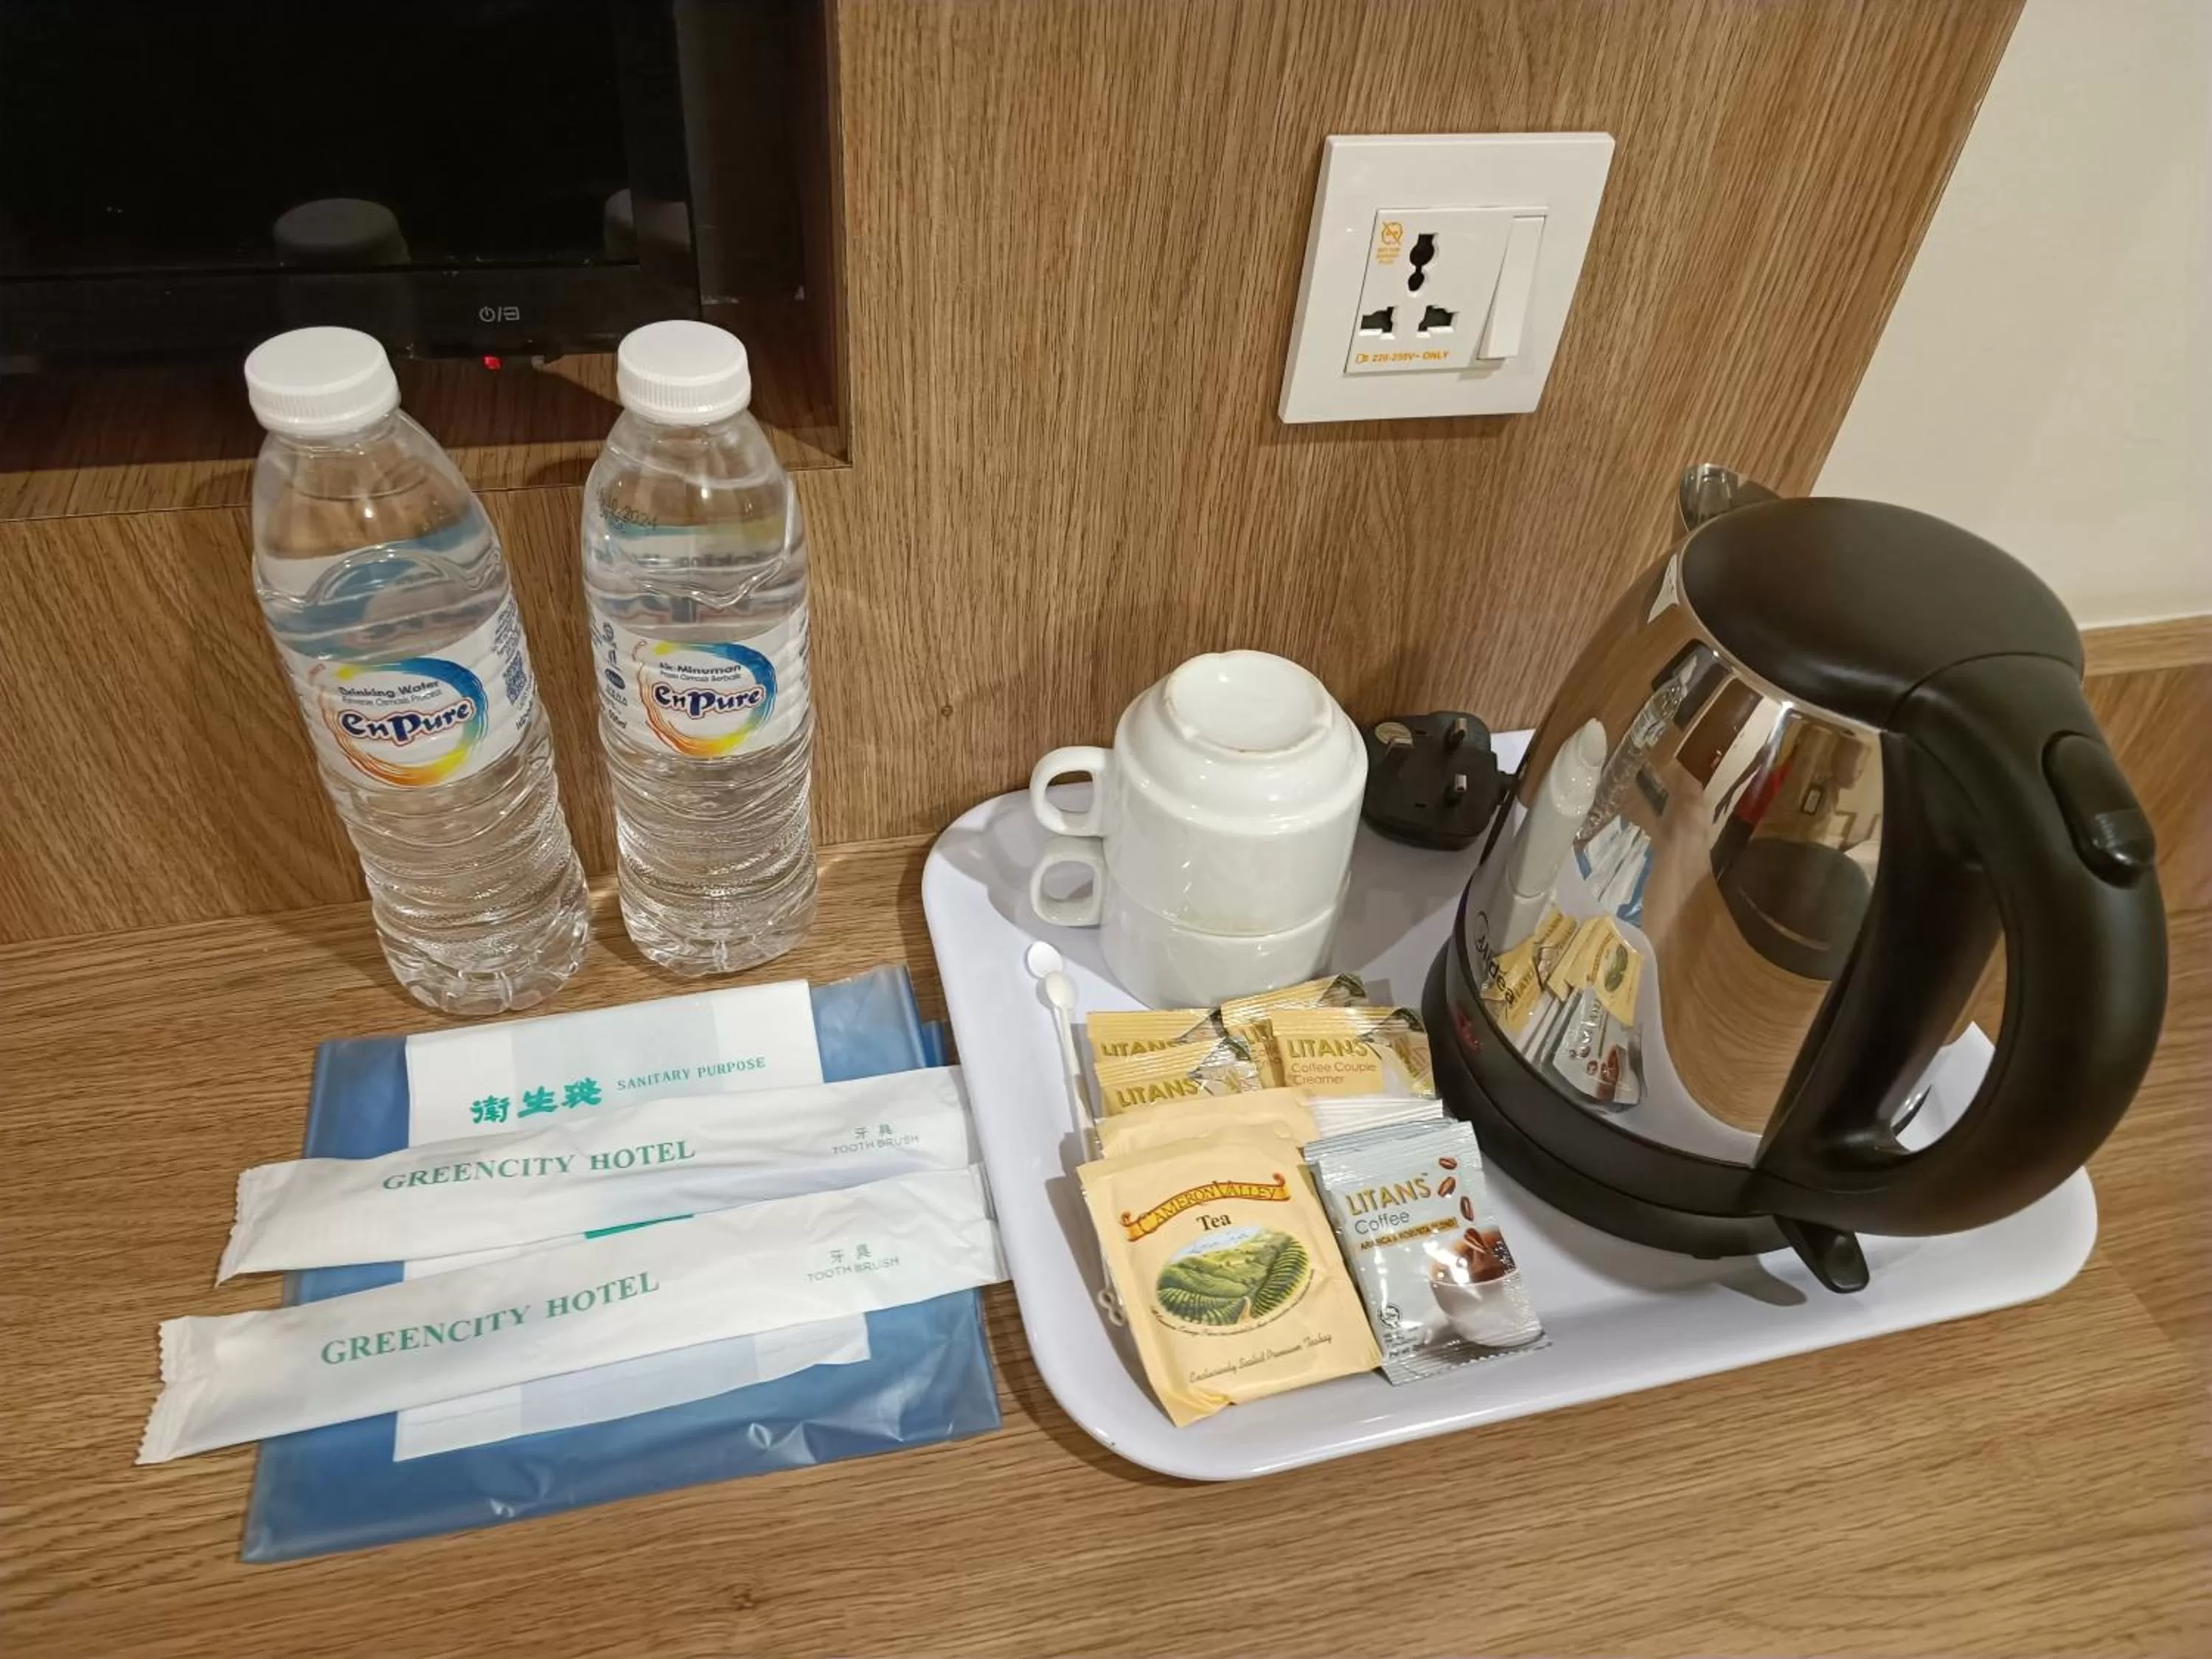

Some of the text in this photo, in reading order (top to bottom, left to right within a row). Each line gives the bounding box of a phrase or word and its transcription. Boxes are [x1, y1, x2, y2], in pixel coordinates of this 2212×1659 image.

[677, 664, 741, 674] Minuman
[338, 681, 439, 698] Drinking Water
[1286, 1037, 1368, 1057] LITANS
[616, 1056, 767, 1091] SANITARY PURPOSE
[1291, 1062, 1331, 1073] Coffee
[1116, 1077, 1199, 1107] LITANS
[1292, 1074, 1345, 1086] Creamer
[382, 1139, 697, 1191] GREENCITY HOTEL
[1138, 1180, 1276, 1234] CAMERON VALLEY
[1346, 1178, 1431, 1216] LITANS
[1195, 1214, 1232, 1231] Tea
[1354, 1211, 1410, 1235] Coffee
[321, 1270, 660, 1365] GREENCITY HOTEL
